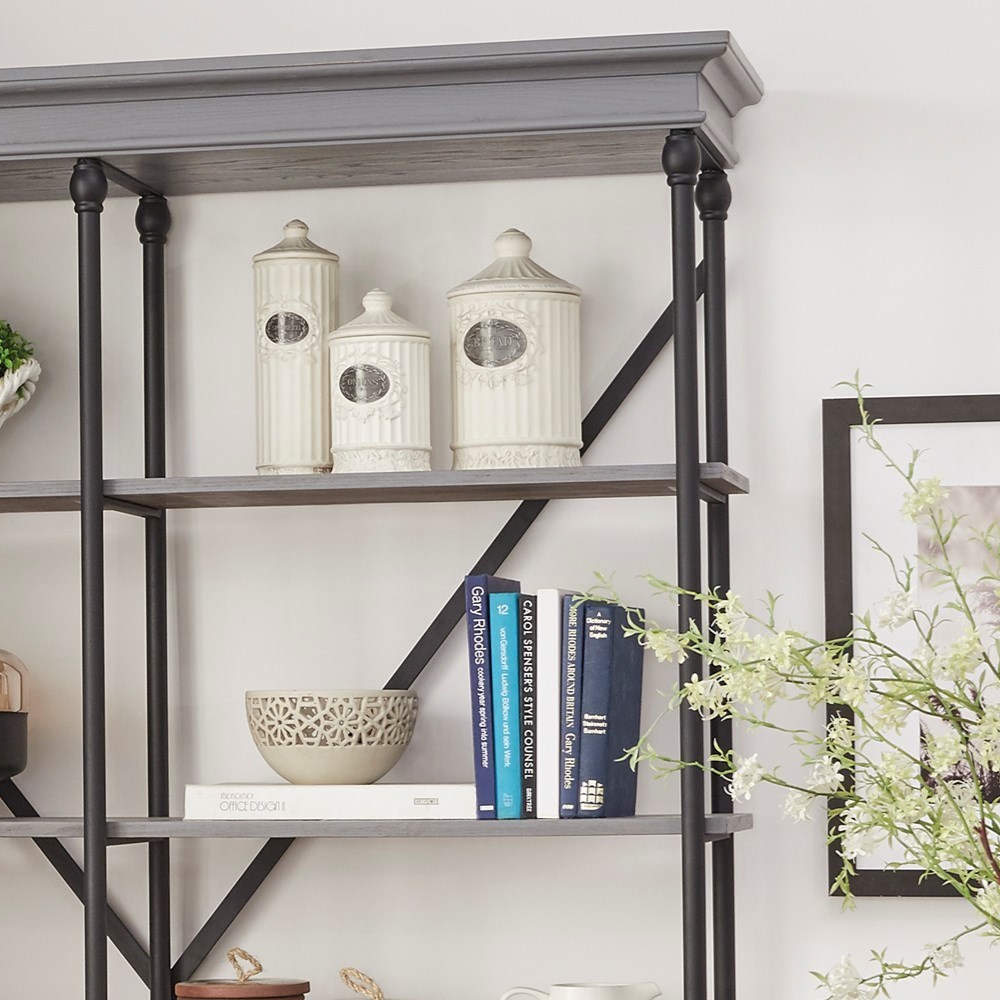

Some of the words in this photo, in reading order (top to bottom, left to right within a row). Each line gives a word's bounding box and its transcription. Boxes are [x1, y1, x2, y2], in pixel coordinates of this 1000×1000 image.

[469, 586, 485, 616] Gary
[496, 604, 509, 616] 12
[522, 600, 533, 636] CAROL
[472, 618, 487, 665] Rhodes
[567, 628, 577, 661] RHODES
[476, 667, 486, 692] cookery
[523, 639, 534, 693] SPENSER'S
[566, 661, 576, 695] AROUND
[478, 692, 486, 707] year
[500, 673, 510, 697] Ludwig
[478, 707, 488, 728] spring
[524, 696, 535, 726] STYLE
[565, 696, 575, 728] BRITAIN
[480, 728, 488, 741] into
[502, 721, 511, 735] und
[481, 741, 489, 769] summer
[524, 730, 534, 779] COUNSEL
[562, 732, 576, 755] Gary
[564, 757, 575, 790] Rhodes
[220, 801, 247, 811] OFFICE
